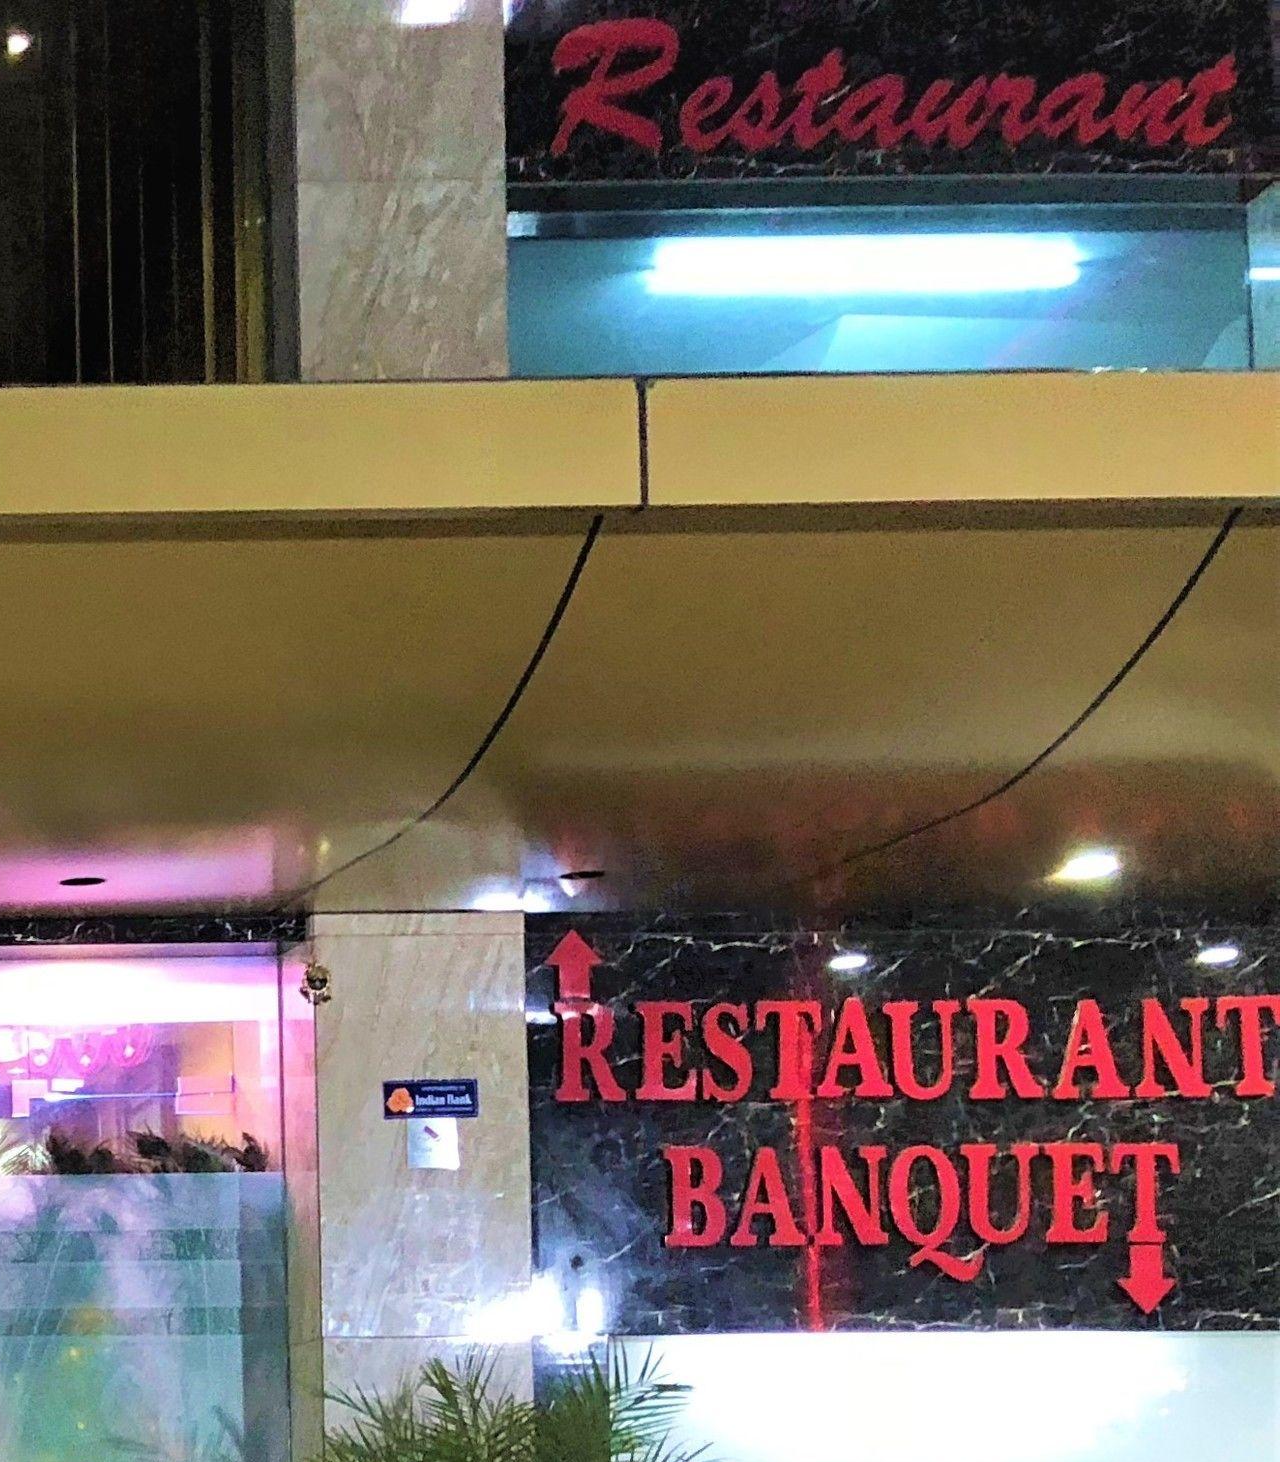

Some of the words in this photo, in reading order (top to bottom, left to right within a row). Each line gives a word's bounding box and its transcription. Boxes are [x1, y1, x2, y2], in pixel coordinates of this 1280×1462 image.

[551, 17, 1237, 157] Restaurant
[555, 996, 1280, 1102] RESTAURANT
[662, 1140, 1181, 1283] BANQUET
